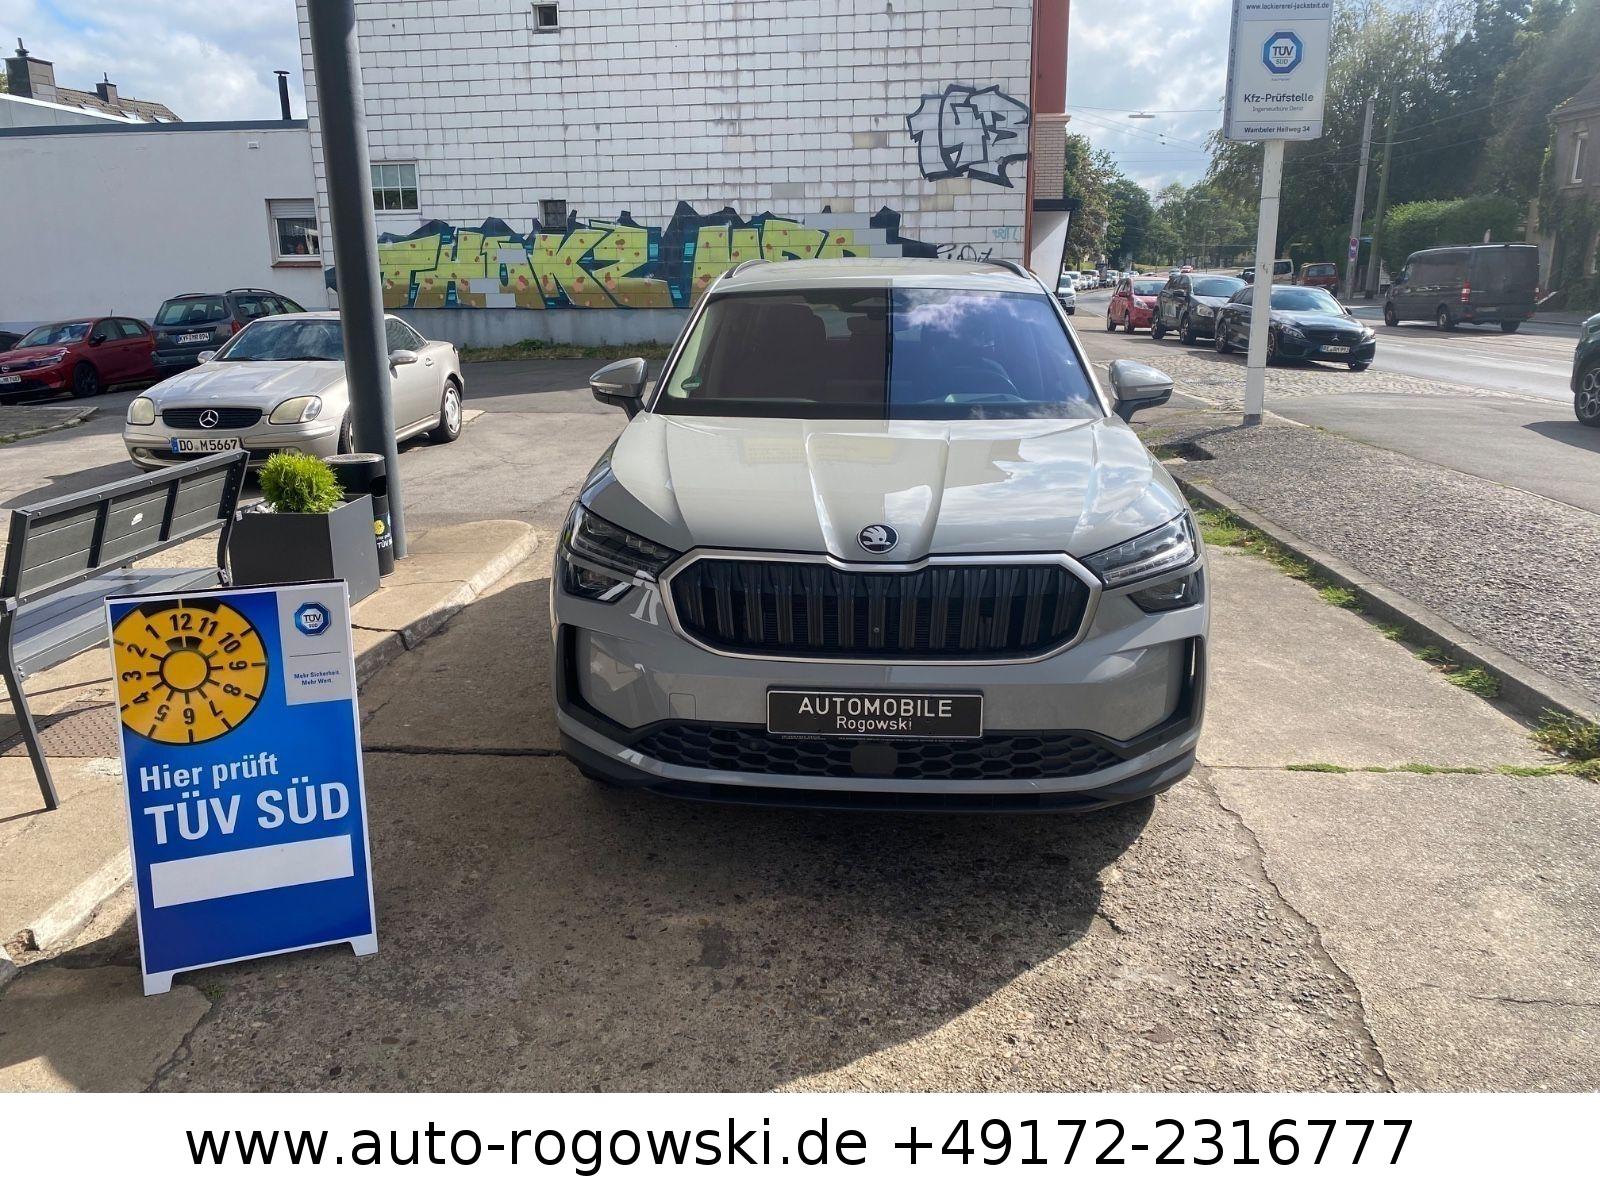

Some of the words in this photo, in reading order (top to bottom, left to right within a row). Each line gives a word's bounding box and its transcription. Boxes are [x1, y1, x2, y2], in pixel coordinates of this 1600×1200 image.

[1272, 45, 1294, 56] TÜV
[1244, 93, 1314, 103] Kfz-Prüfstelle
[1244, 126, 1276, 134] Wambeler
[179, 440, 194, 451] DO
[169, 613, 193, 632] 12
[303, 612, 322, 624] TÜV
[145, 624, 161, 639] 1
[198, 615, 218, 637] 11
[126, 642, 148, 657] 2
[218, 632, 241, 654] 10
[228, 660, 248, 672] 9
[122, 670, 142, 682] 3
[294, 671, 308, 680] Mehr
[301, 678, 316, 686] Mehr
[132, 690, 149, 705] 4
[222, 682, 242, 699] 8
[154, 704, 170, 722] 5
[208, 700, 224, 718] 7
[798, 696, 953, 718] AUTOMOBILE
[182, 707, 195, 725] 6
[836, 716, 912, 732] Rogowski
[140, 764, 203, 792] Hier
[212, 752, 279, 790] prüft
[144, 790, 241, 845] TÜV
[256, 776, 350, 829] SÜD
